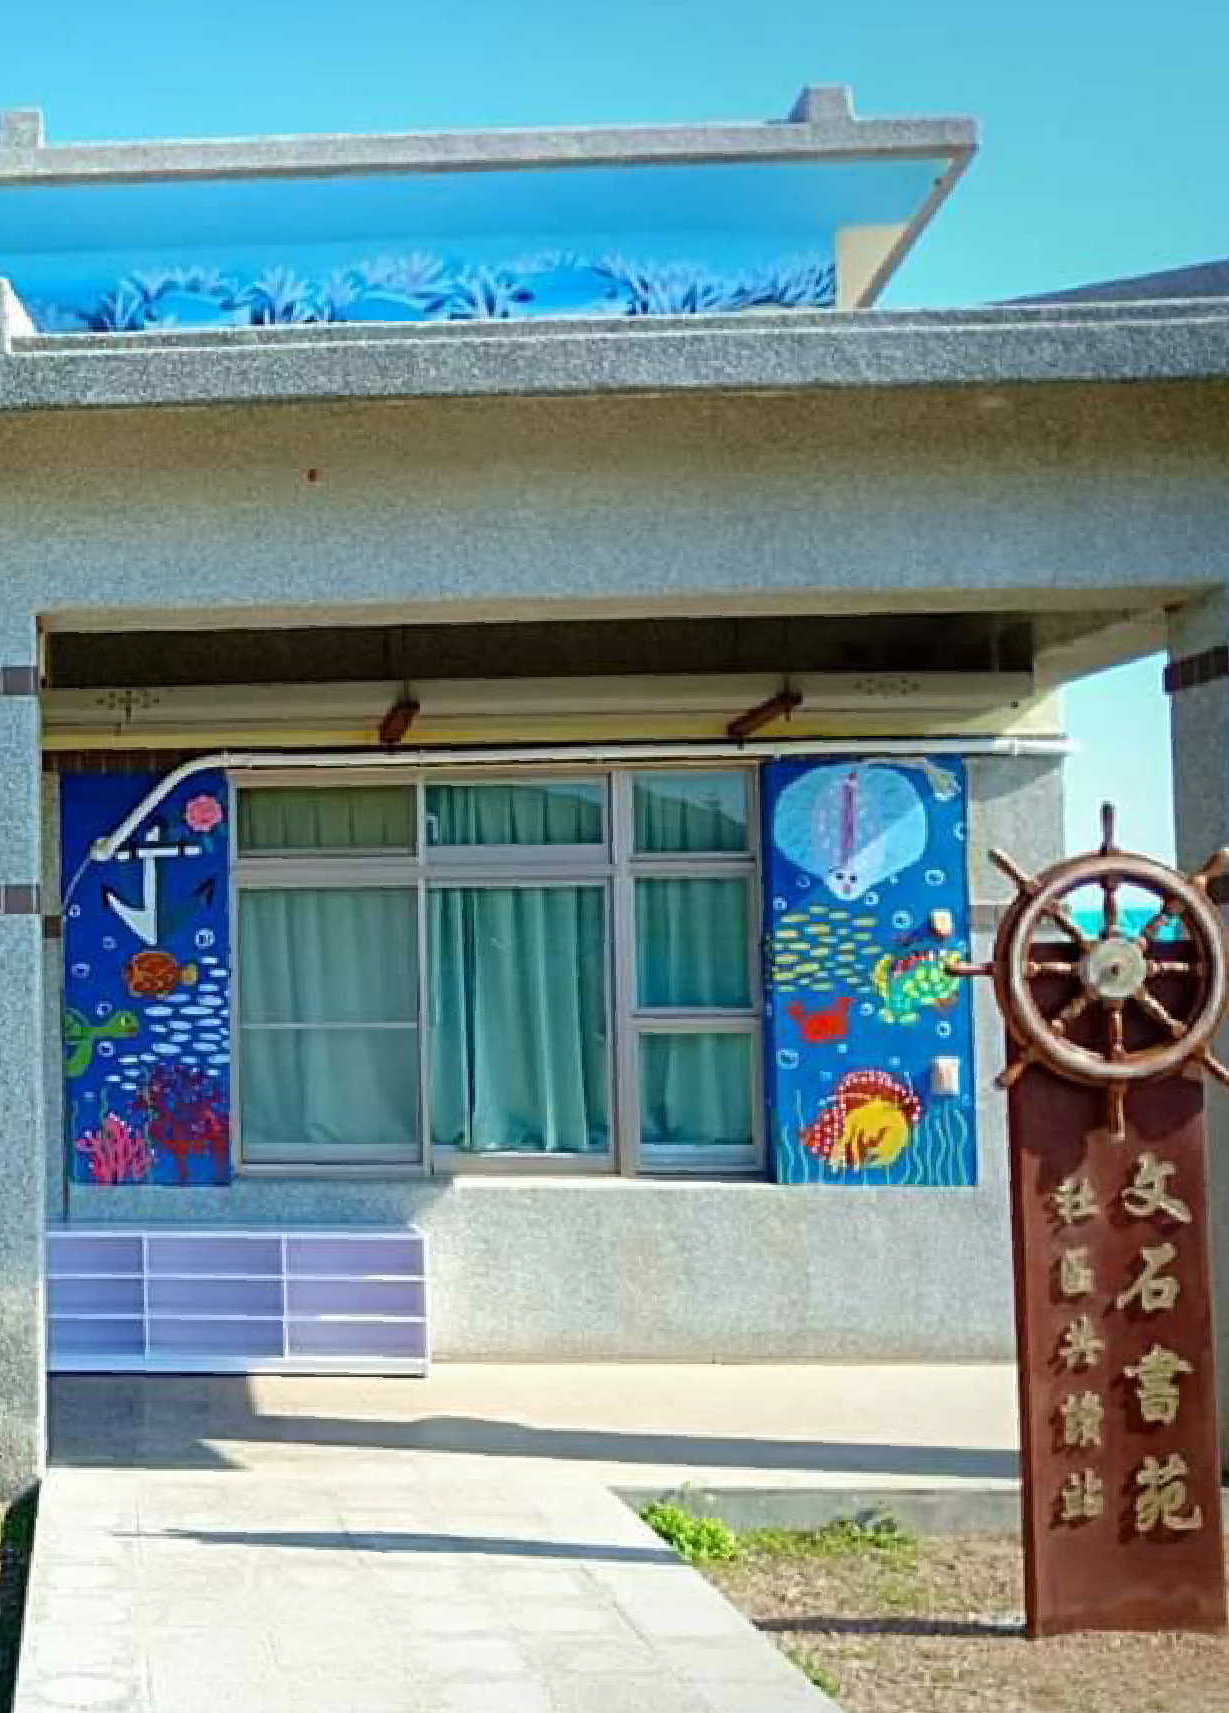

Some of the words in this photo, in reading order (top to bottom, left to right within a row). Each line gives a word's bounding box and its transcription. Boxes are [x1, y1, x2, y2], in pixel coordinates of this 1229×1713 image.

[1054, 1176, 1105, 1522] 社區共讀站
[1117, 1151, 1203, 1532] 文石書苑
